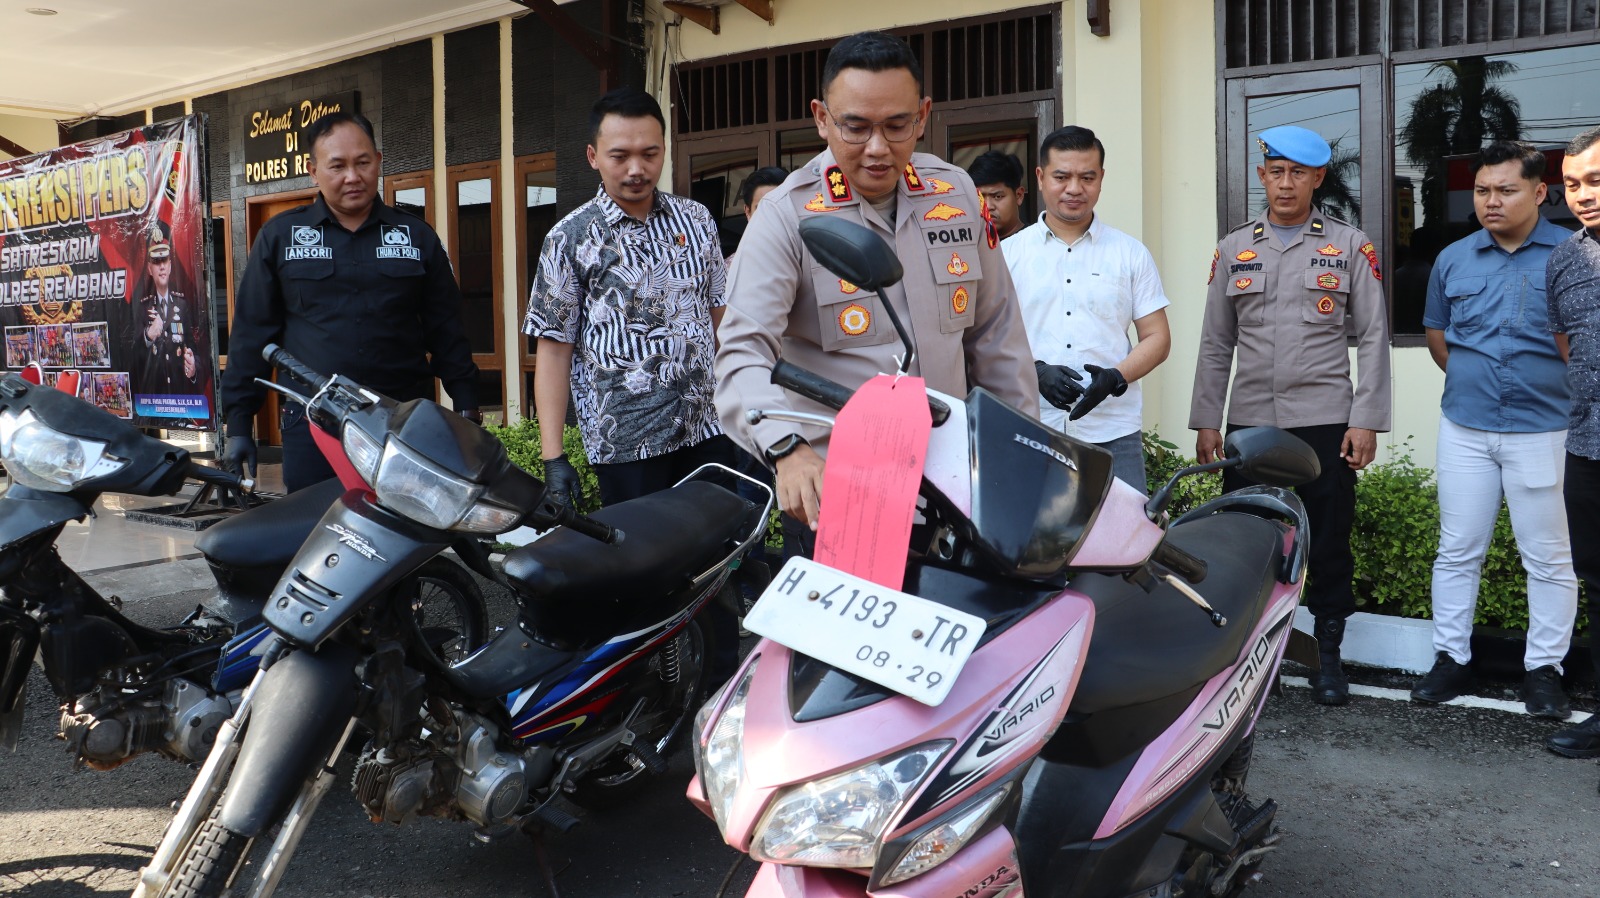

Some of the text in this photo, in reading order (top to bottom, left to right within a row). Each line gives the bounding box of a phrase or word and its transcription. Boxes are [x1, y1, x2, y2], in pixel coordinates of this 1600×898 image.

[250, 107, 293, 138] Selamat
[286, 131, 298, 153] DI
[82, 150, 148, 217] PERS
[246, 158, 288, 183] POLRES
[927, 227, 973, 245] POLRI
[1, 236, 99, 272] SATRESKRIM
[288, 248, 329, 259] ANSORI
[379, 247, 401, 258] HUMAS
[1311, 258, 1348, 270] POLRI
[44, 269, 126, 302] REMBANG
[1013, 433, 1078, 471] HONDA
[345, 540, 373, 559] HONDA
[777, 567, 967, 656] H 4193 TR
[1202, 635, 1270, 730] VARIO
[983, 685, 1055, 741] VARIO
